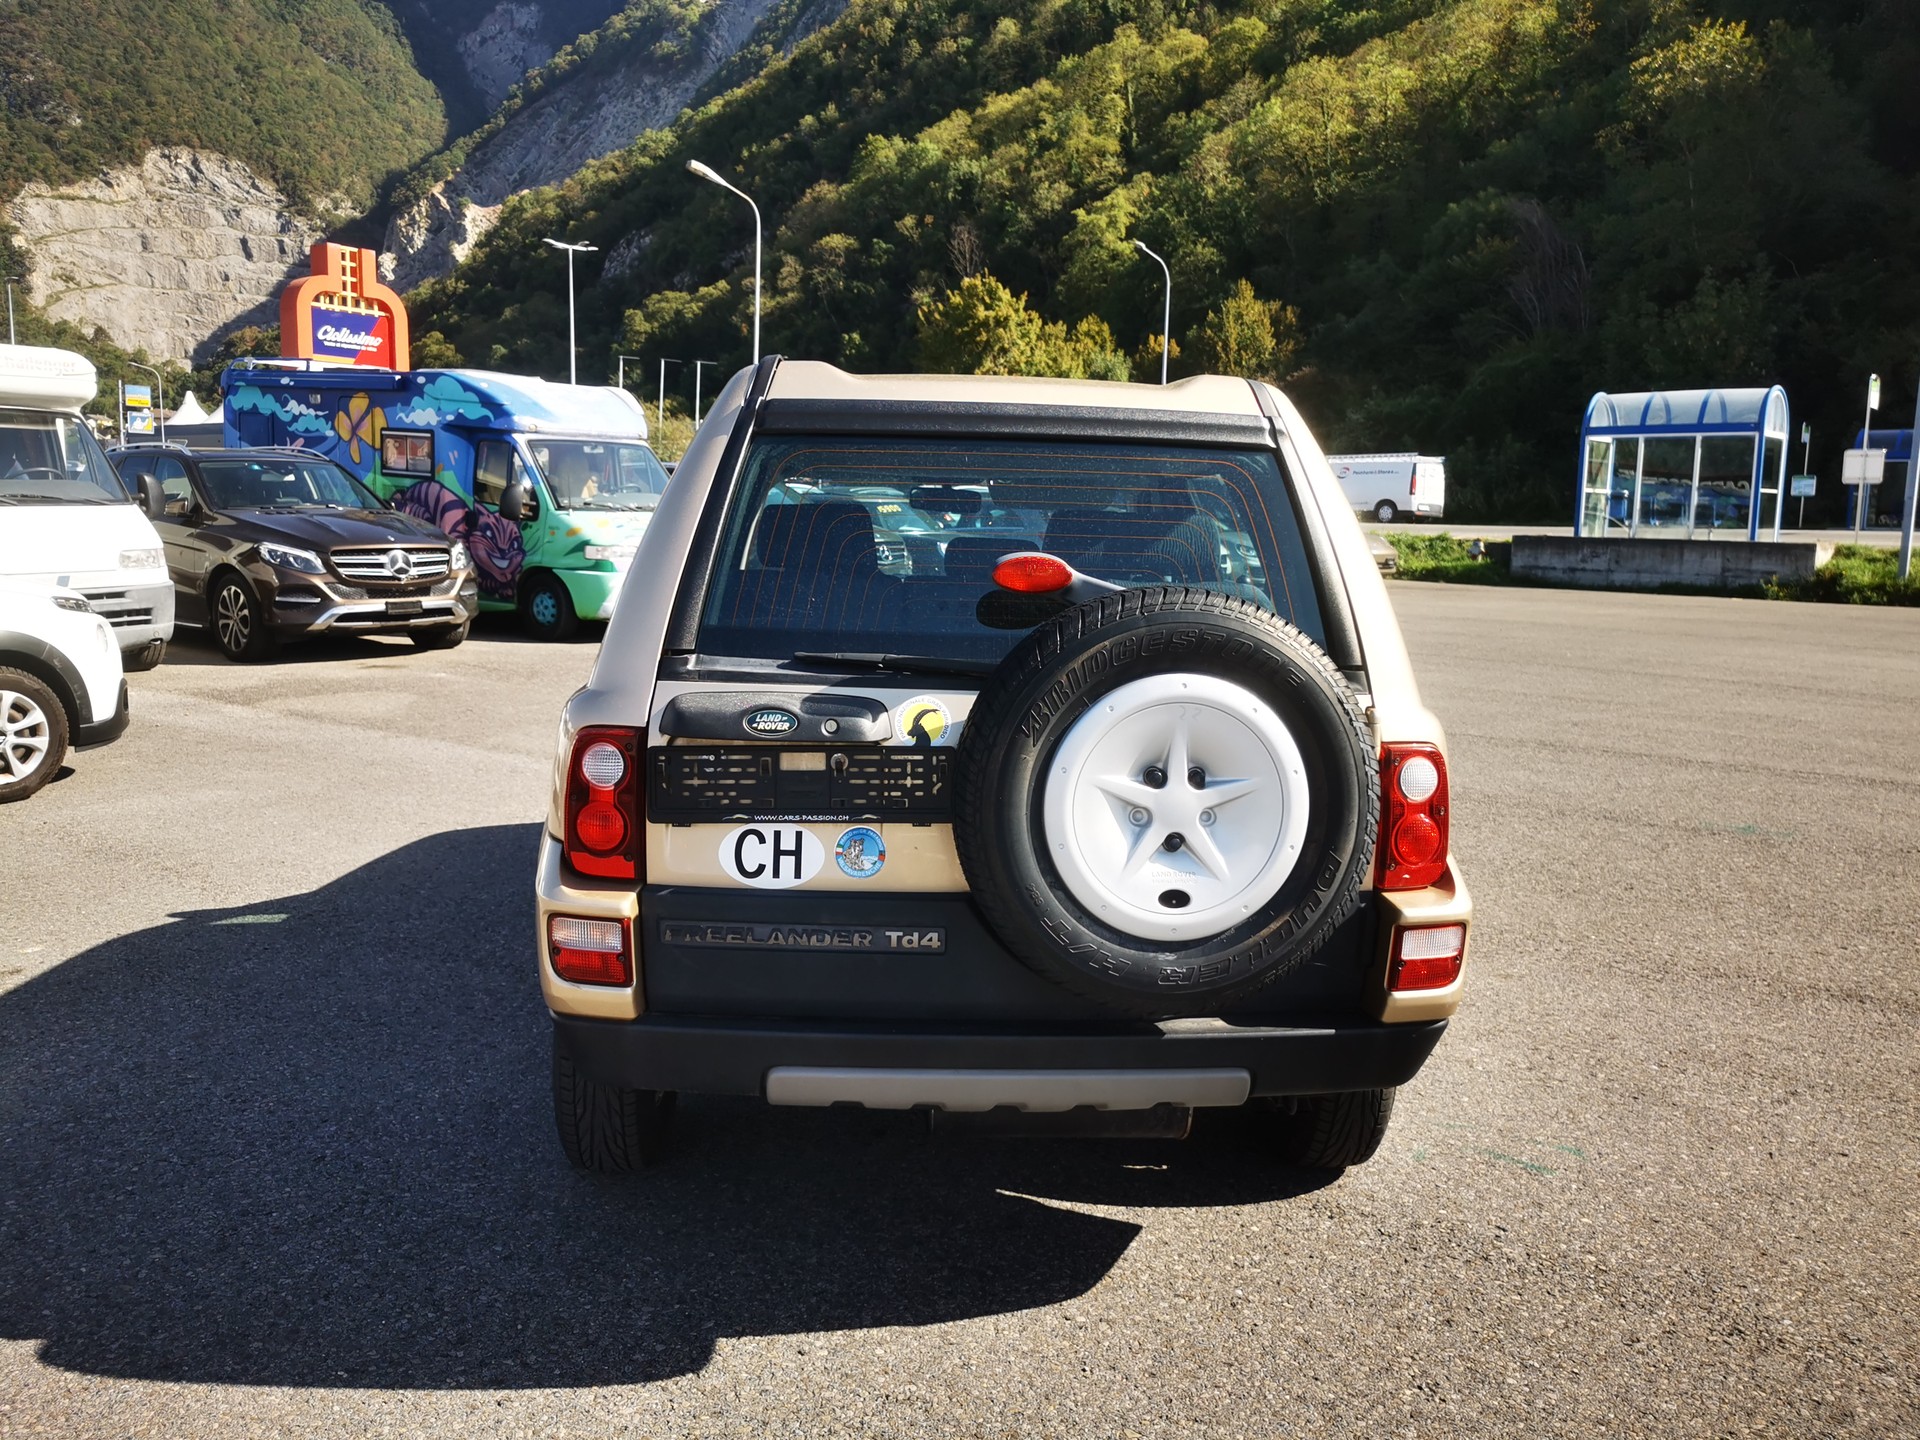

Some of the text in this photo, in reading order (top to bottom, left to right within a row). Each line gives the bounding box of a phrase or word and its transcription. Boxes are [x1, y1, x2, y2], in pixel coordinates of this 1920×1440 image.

[1021, 627, 1307, 748] BRIDGESTONE
[756, 714, 782, 722] LAND
[757, 722, 790, 731] ROVER
[734, 828, 804, 880] CH
[664, 924, 941, 949] FREELANDER Td4
[1157, 849, 1345, 986] DUELER
